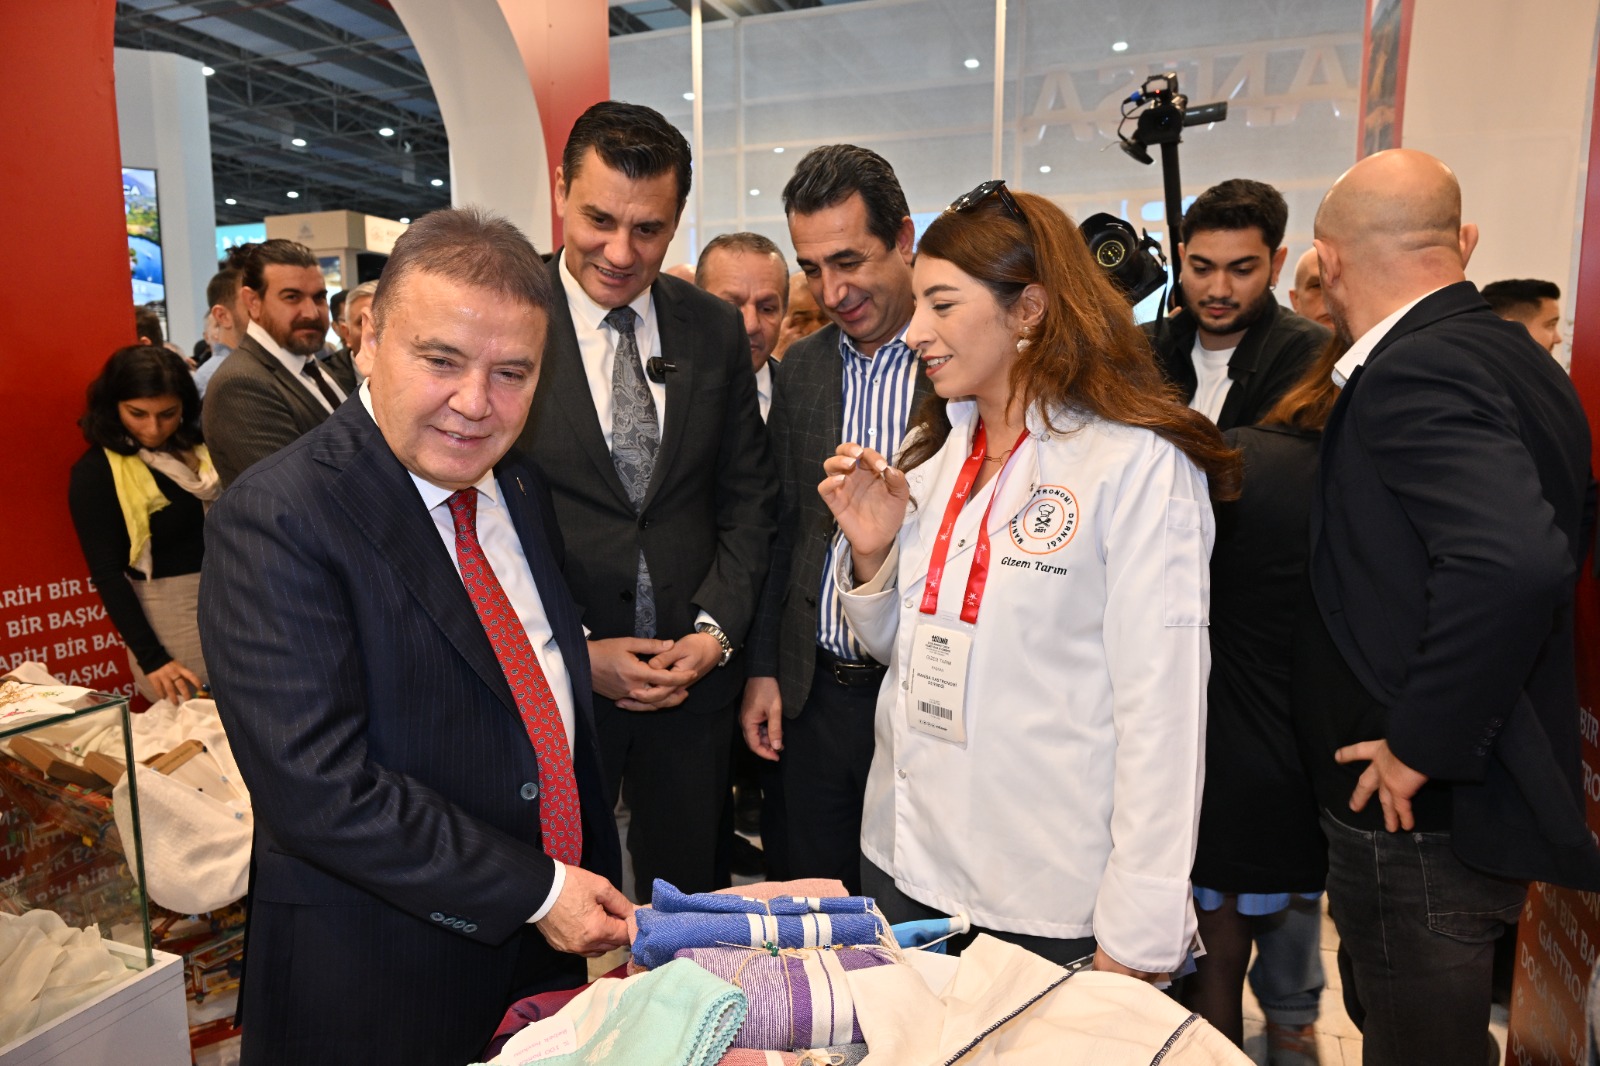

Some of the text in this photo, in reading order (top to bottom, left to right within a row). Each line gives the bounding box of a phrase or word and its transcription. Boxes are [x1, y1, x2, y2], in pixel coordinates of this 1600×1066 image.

[1034, 561, 1067, 576] Tarım
[0, 584, 42, 608] RİH
[47, 577, 82, 600] BİR
[6, 614, 43, 638] BİR
[53, 637, 88, 660] BİR
[1580, 706, 1599, 748] BİR
